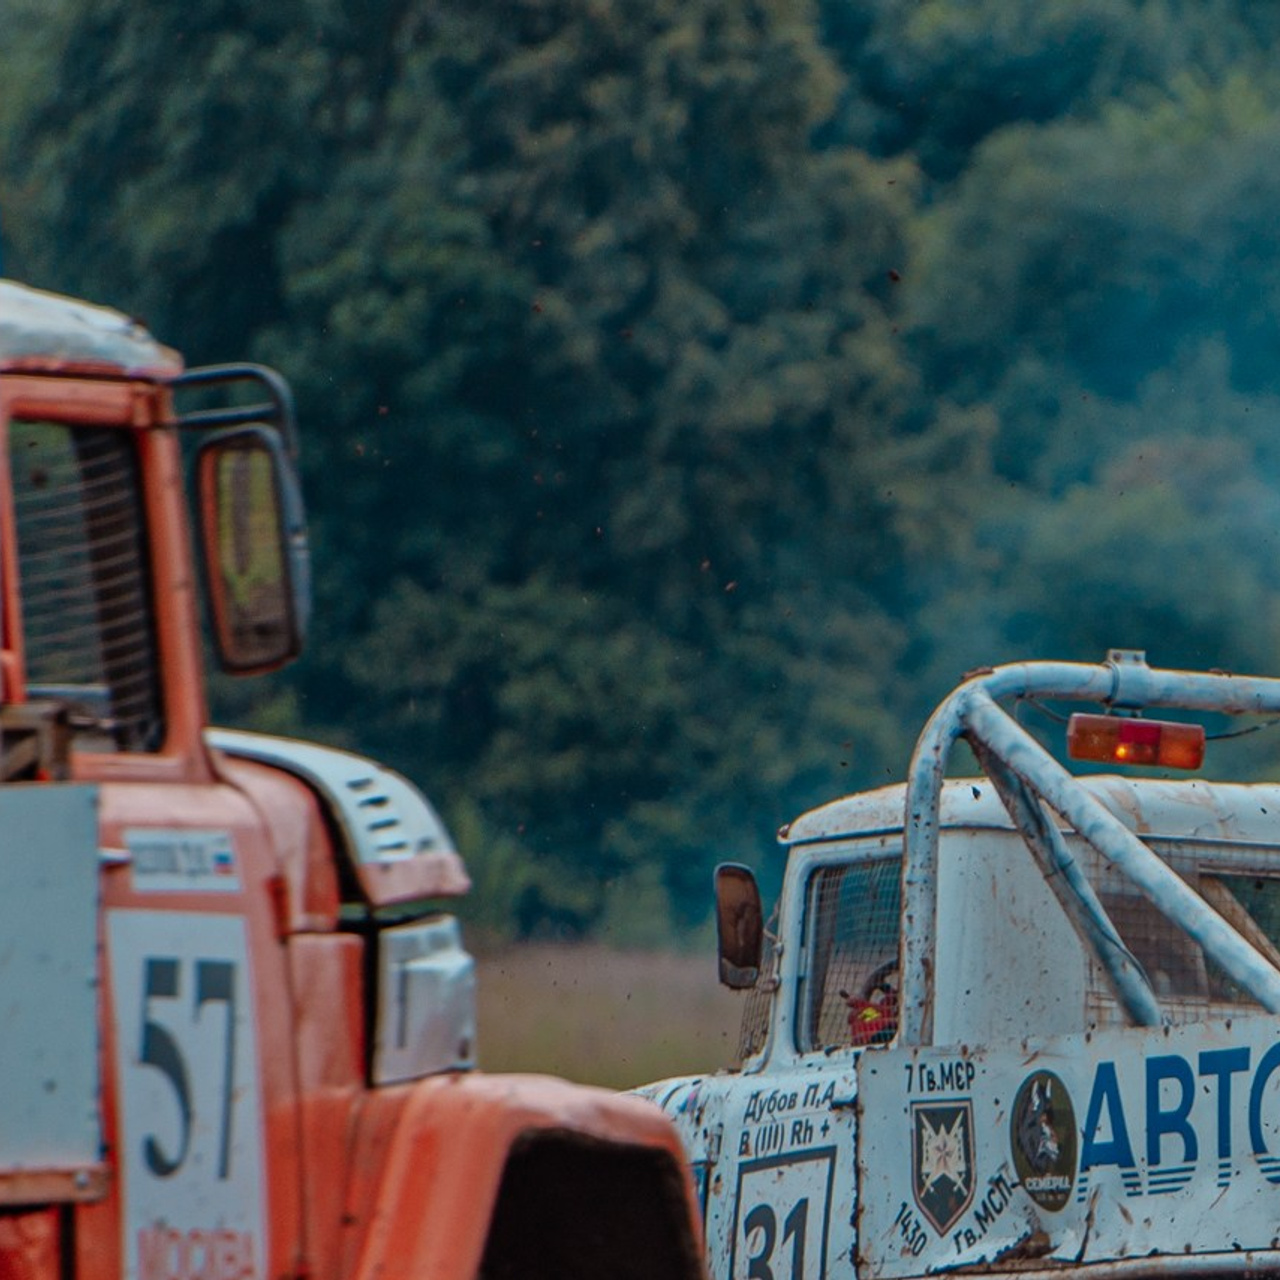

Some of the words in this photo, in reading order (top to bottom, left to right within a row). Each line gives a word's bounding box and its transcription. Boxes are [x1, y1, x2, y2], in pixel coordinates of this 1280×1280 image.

[137, 956, 238, 1182] 57
[904, 1063, 914, 1094] 7
[743, 1088, 799, 1124] Дубов
[790, 1117, 814, 1147] Rh
[893, 1201, 928, 1257] 1430
